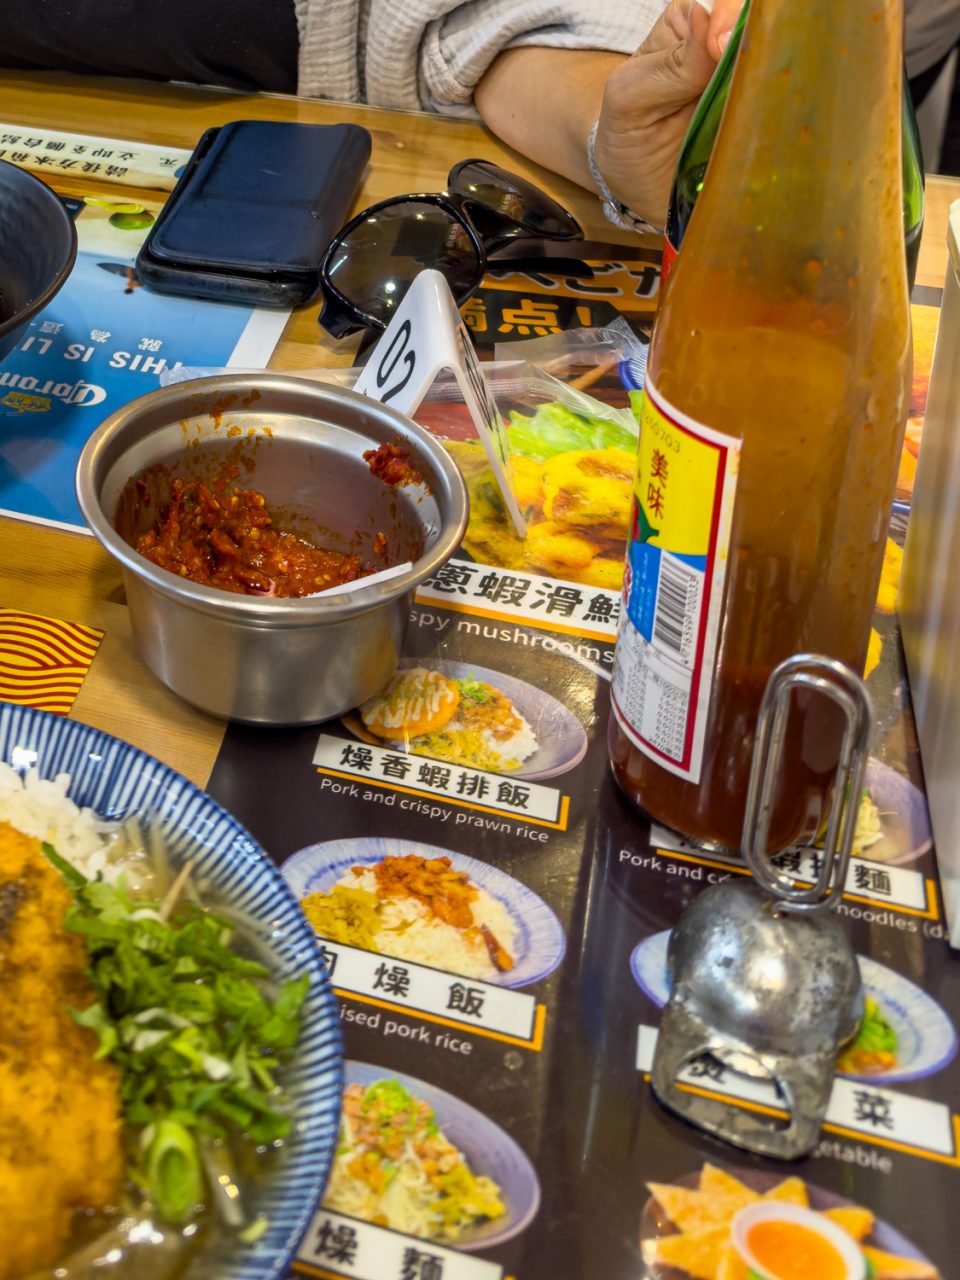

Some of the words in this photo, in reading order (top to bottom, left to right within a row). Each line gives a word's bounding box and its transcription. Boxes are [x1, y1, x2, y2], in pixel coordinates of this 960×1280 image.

[19, 336, 53, 355] LI
[64, 343, 95, 363] IS
[646, 448, 669, 520] 美味
[409, 609, 450, 632] spy
[457, 620, 615, 664] mushrooms
[339, 743, 531, 810] 燥香蝦排飯
[320, 778, 359, 798] Pork
[362, 789, 396, 806] and
[400, 797, 452, 822] crispy
[455, 810, 511, 835] prawn
[515, 824, 550, 843] rice
[619, 849, 661, 871] Pork
[666, 860, 702, 881] and
[836, 902, 918, 933] noodles
[340, 1004, 381, 1028] ised
[384, 1019, 430, 1044] pork
[435, 1033, 474, 1056] rice
[812, 1139, 893, 1171] etable
